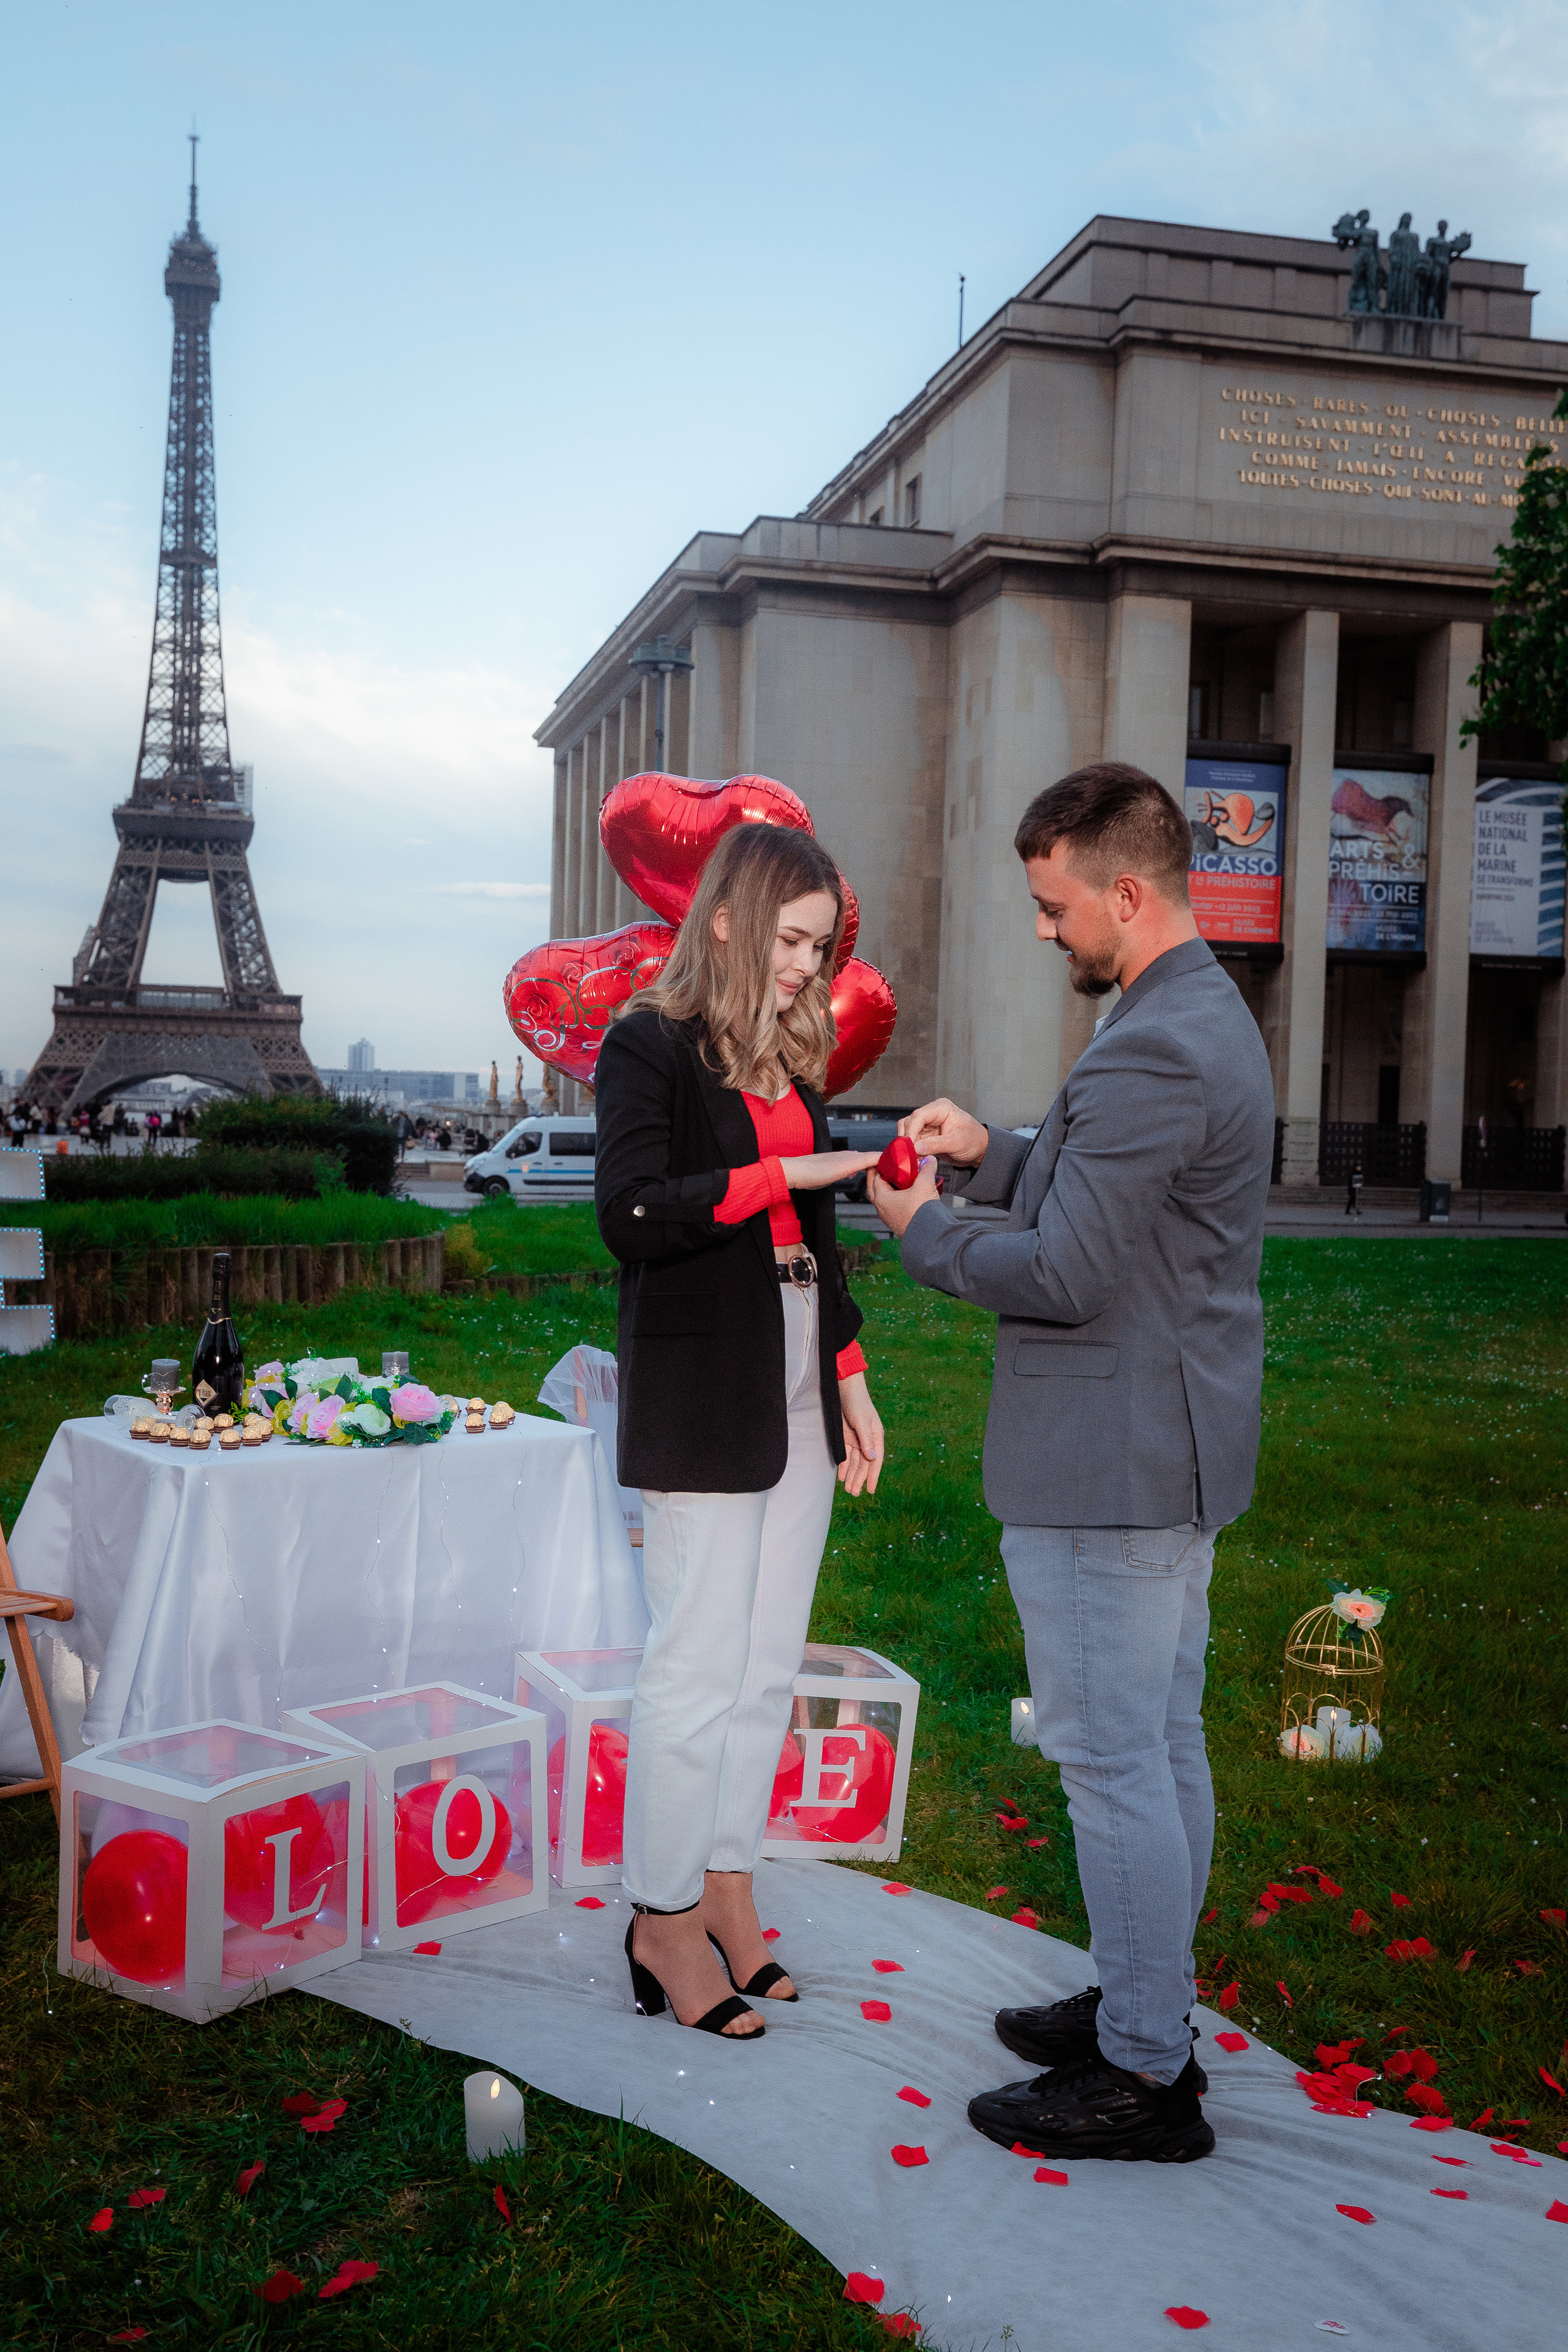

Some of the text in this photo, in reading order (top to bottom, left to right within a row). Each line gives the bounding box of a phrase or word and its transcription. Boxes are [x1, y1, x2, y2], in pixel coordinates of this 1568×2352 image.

[1221, 387, 1568, 435] CHOSES RARES OU CHOSES BELLE
[1240, 409, 1269, 425] ICI
[1295, 415, 1411, 439] SAVAMMENT
[1219, 426, 1351, 453] INSTRUISENT
[1251, 450, 1318, 472] COMME
[1412, 466, 1485, 488] ENCORE
[1237, 469, 1300, 491] TOUTES
[1310, 475, 1373, 497] CHOSES
[1420, 486, 1462, 503] SONT
[1479, 810, 1527, 826] LE MUSÉE
[1477, 842, 1507, 856] DE LA
[1478, 826, 1528, 842] NATIONAL
[1330, 840, 1420, 870] ARTS &
[1477, 858, 1516, 873] MARINE
[789, 1728, 866, 1808] E
[432, 1773, 496, 1876] O
[262, 1826, 328, 1931] L
